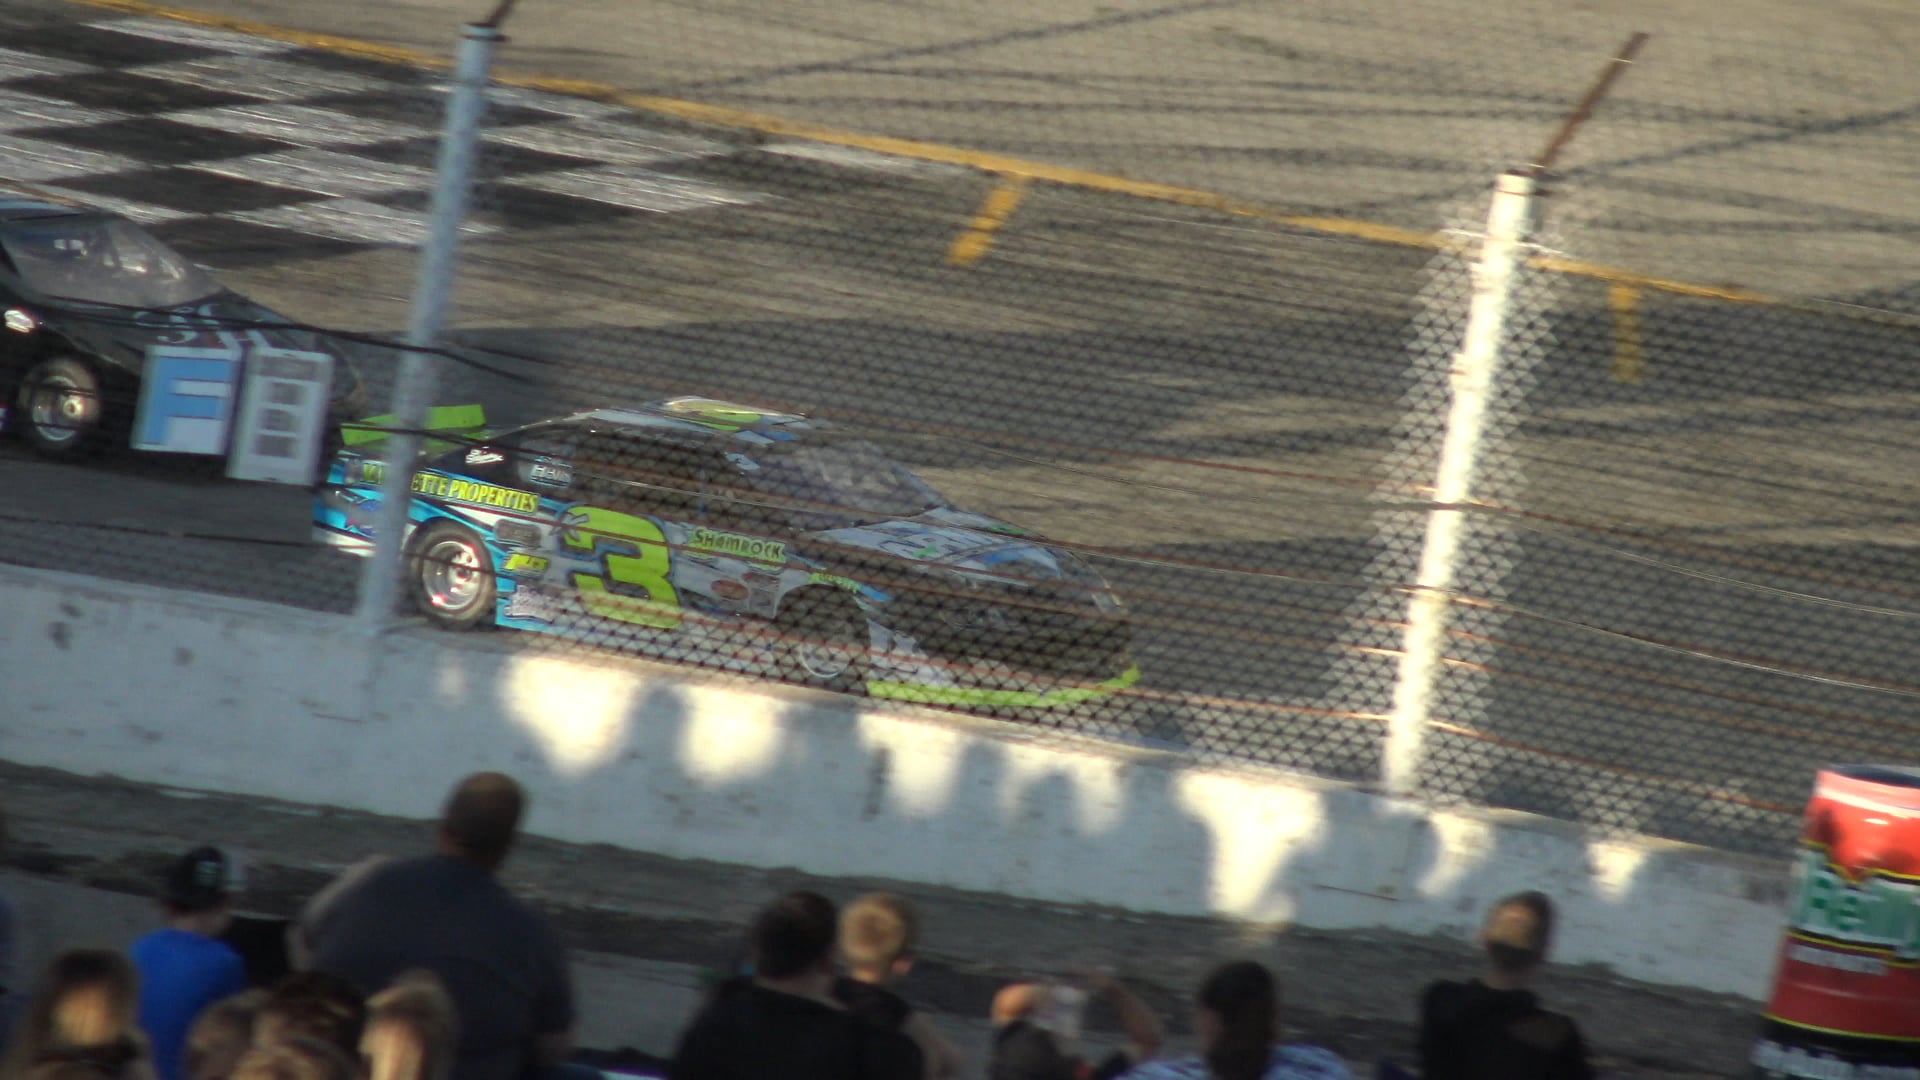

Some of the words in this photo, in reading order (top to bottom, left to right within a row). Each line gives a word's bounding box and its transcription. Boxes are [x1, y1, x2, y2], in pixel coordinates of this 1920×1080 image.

[448, 478, 539, 513] PROPERTIES
[694, 528, 783, 560] SHAMROCK
[562, 505, 681, 629] 3
